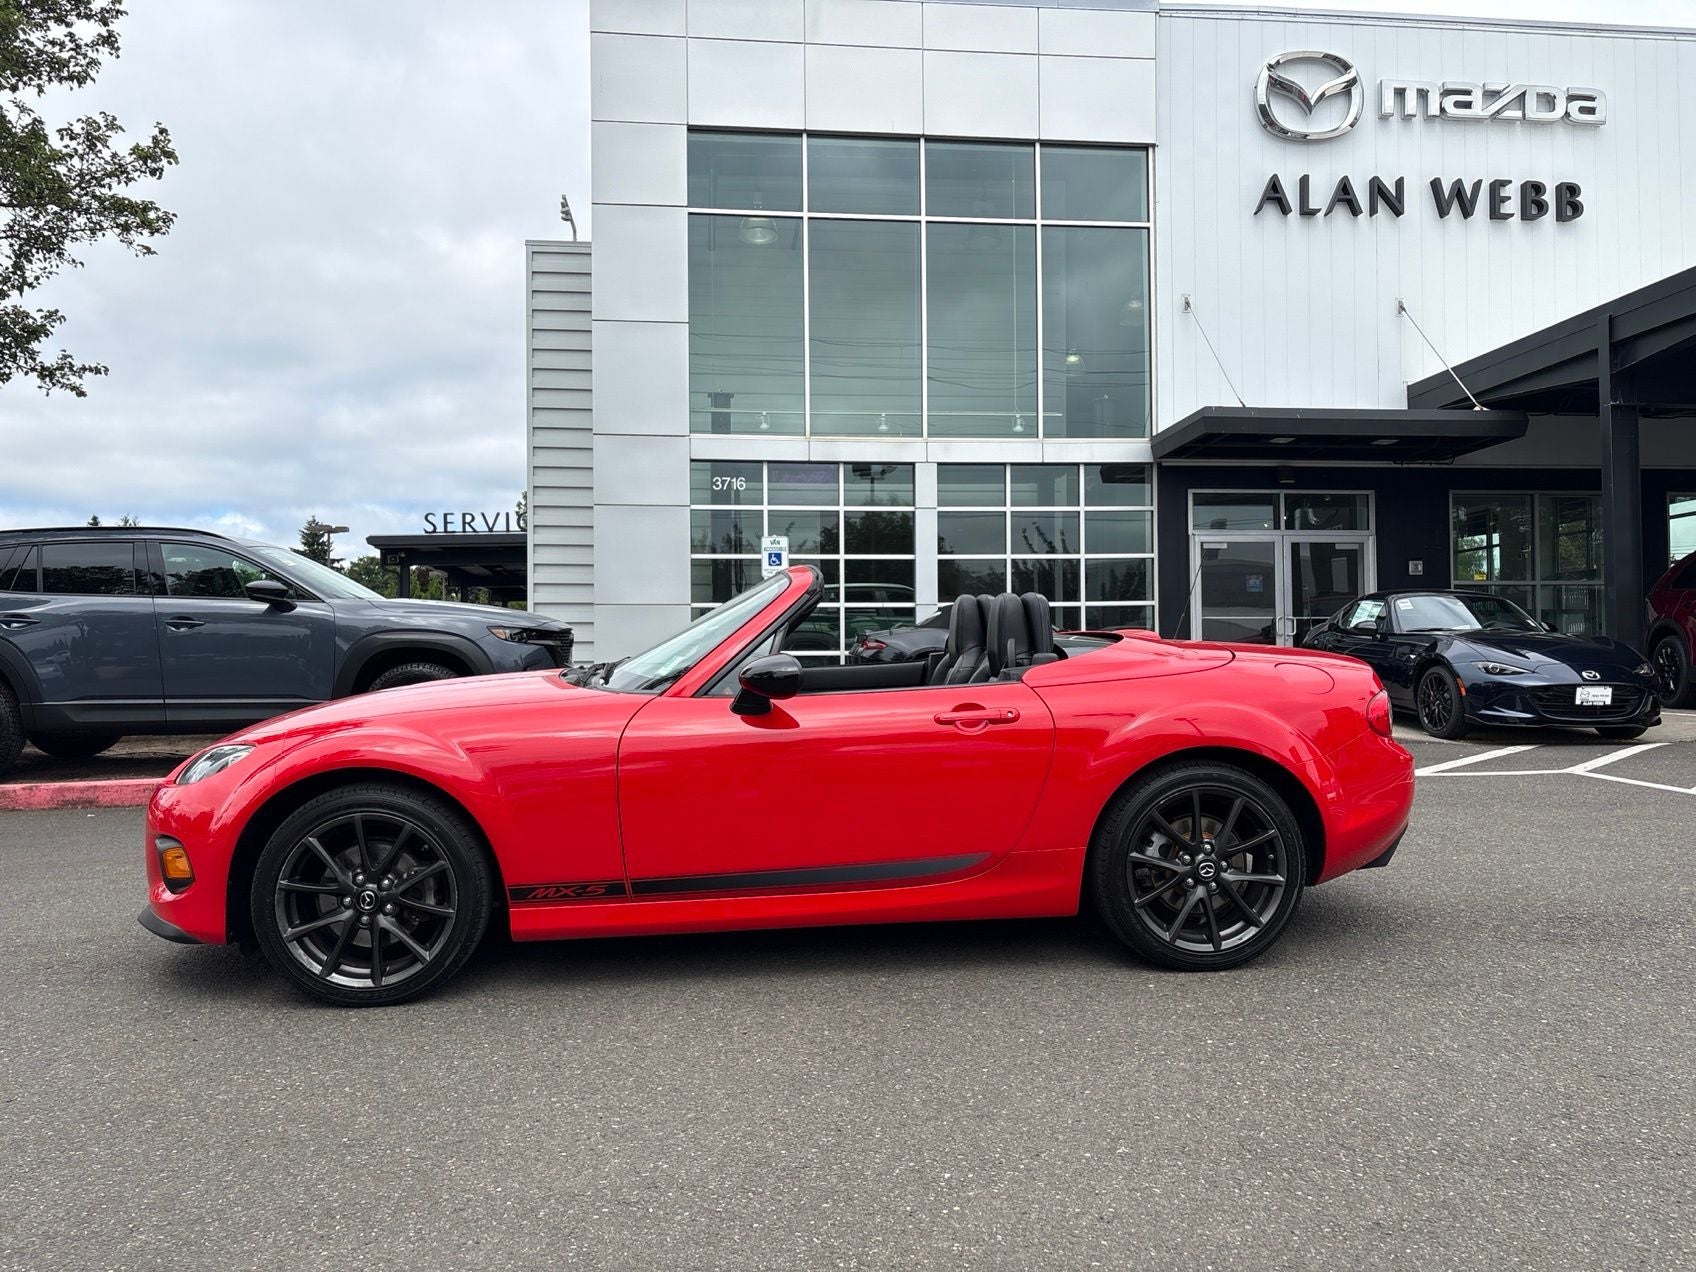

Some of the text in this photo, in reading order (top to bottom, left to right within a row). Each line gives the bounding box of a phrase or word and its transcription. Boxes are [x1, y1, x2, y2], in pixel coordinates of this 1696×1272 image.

[1253, 173, 1586, 223] ALAN WEBB
[712, 476, 746, 491] 3716
[769, 538, 781, 546] VAN
[527, 884, 609, 899] MX-5
